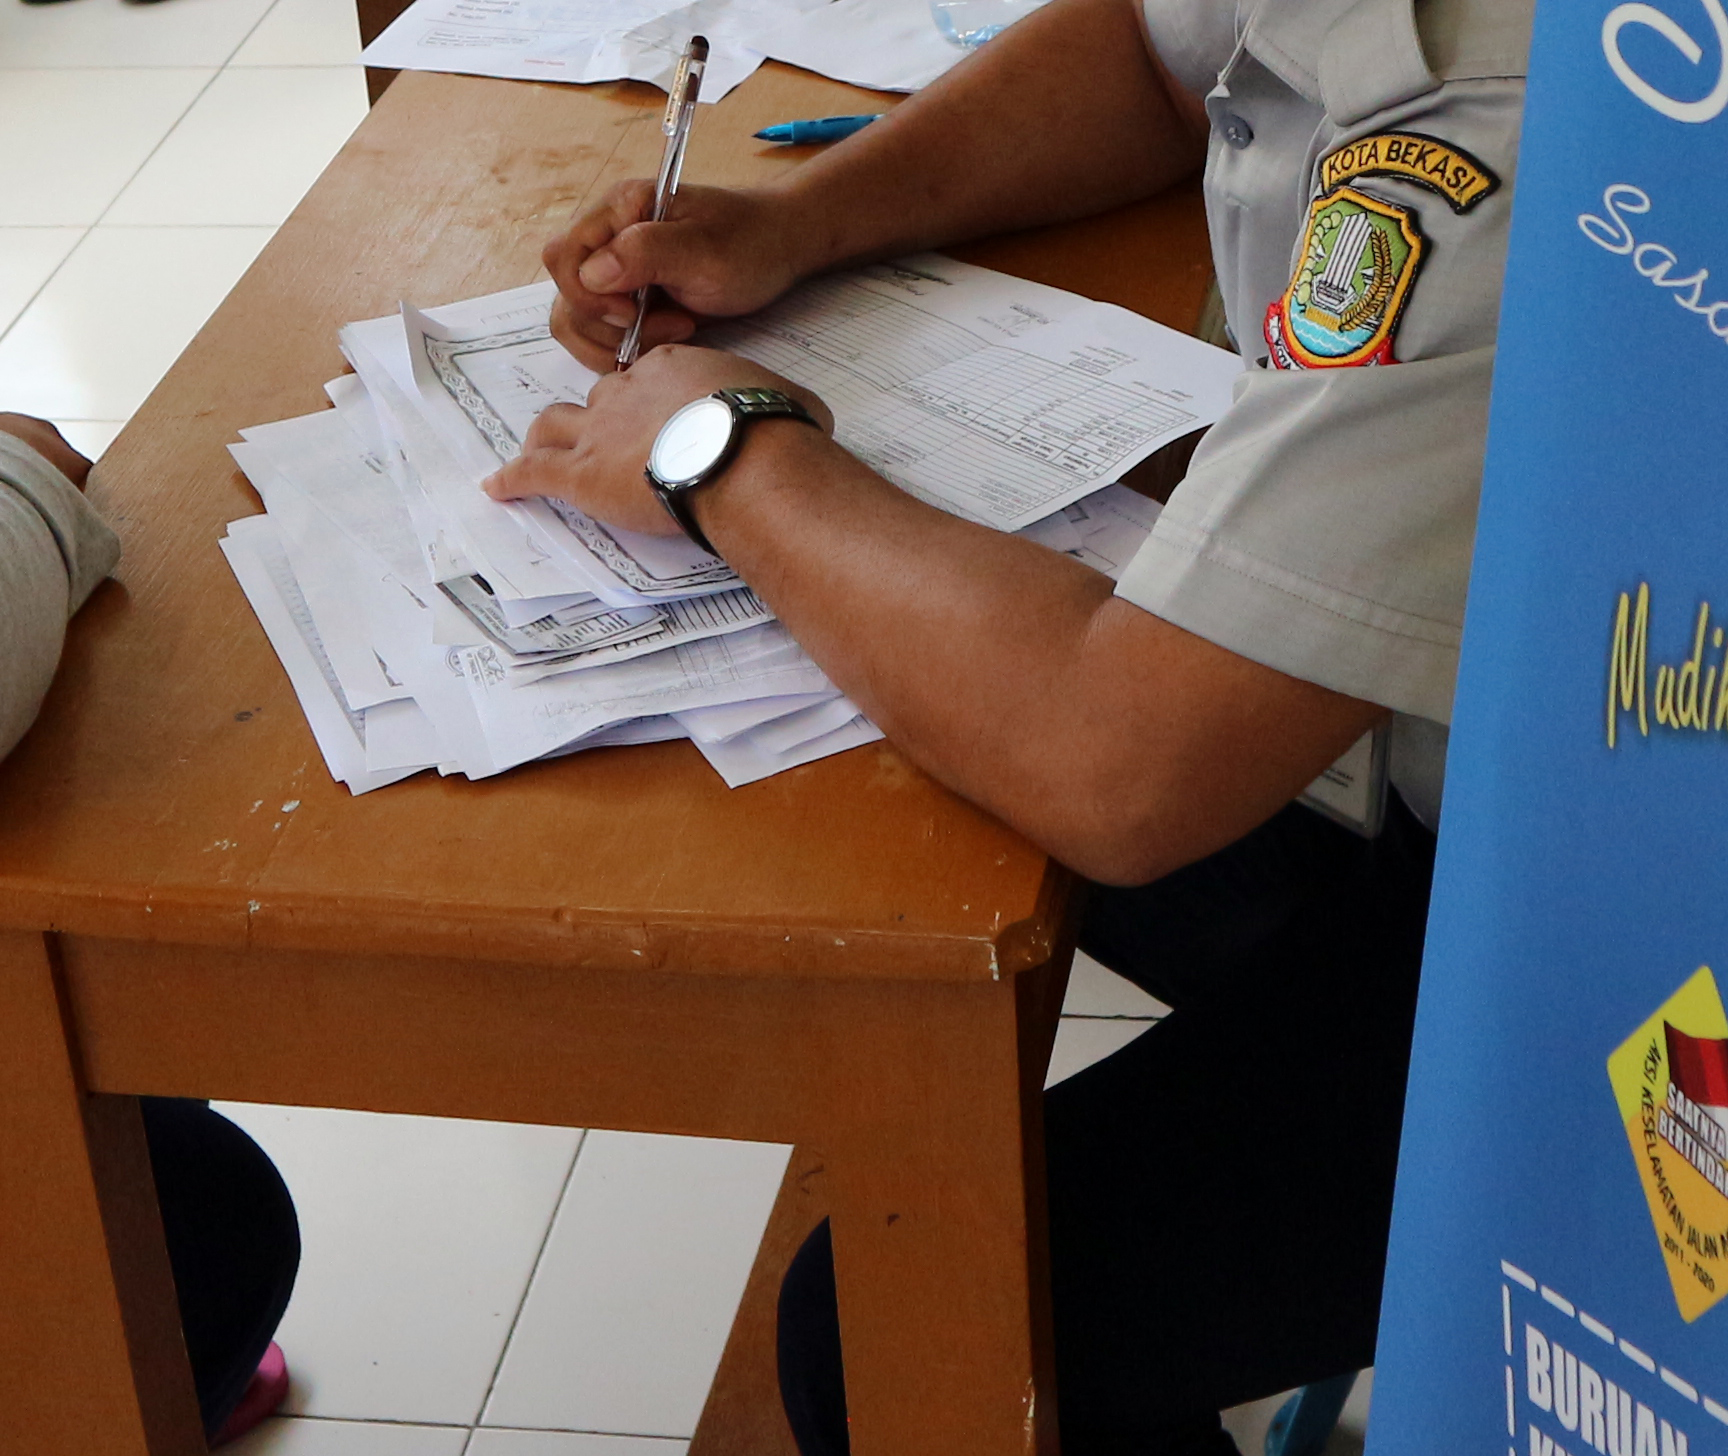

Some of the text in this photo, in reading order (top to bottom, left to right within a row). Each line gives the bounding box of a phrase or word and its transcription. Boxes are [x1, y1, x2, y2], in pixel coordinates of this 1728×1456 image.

[1329, 139, 1476, 197] KOTA BEKASI
[1642, 1037, 1663, 1085] AKSI
[1667, 1081, 1726, 1160] SAATNYA
[1640, 1084, 1685, 1235] KESELAMATAN
[1687, 1225, 1719, 1261] JALAN
